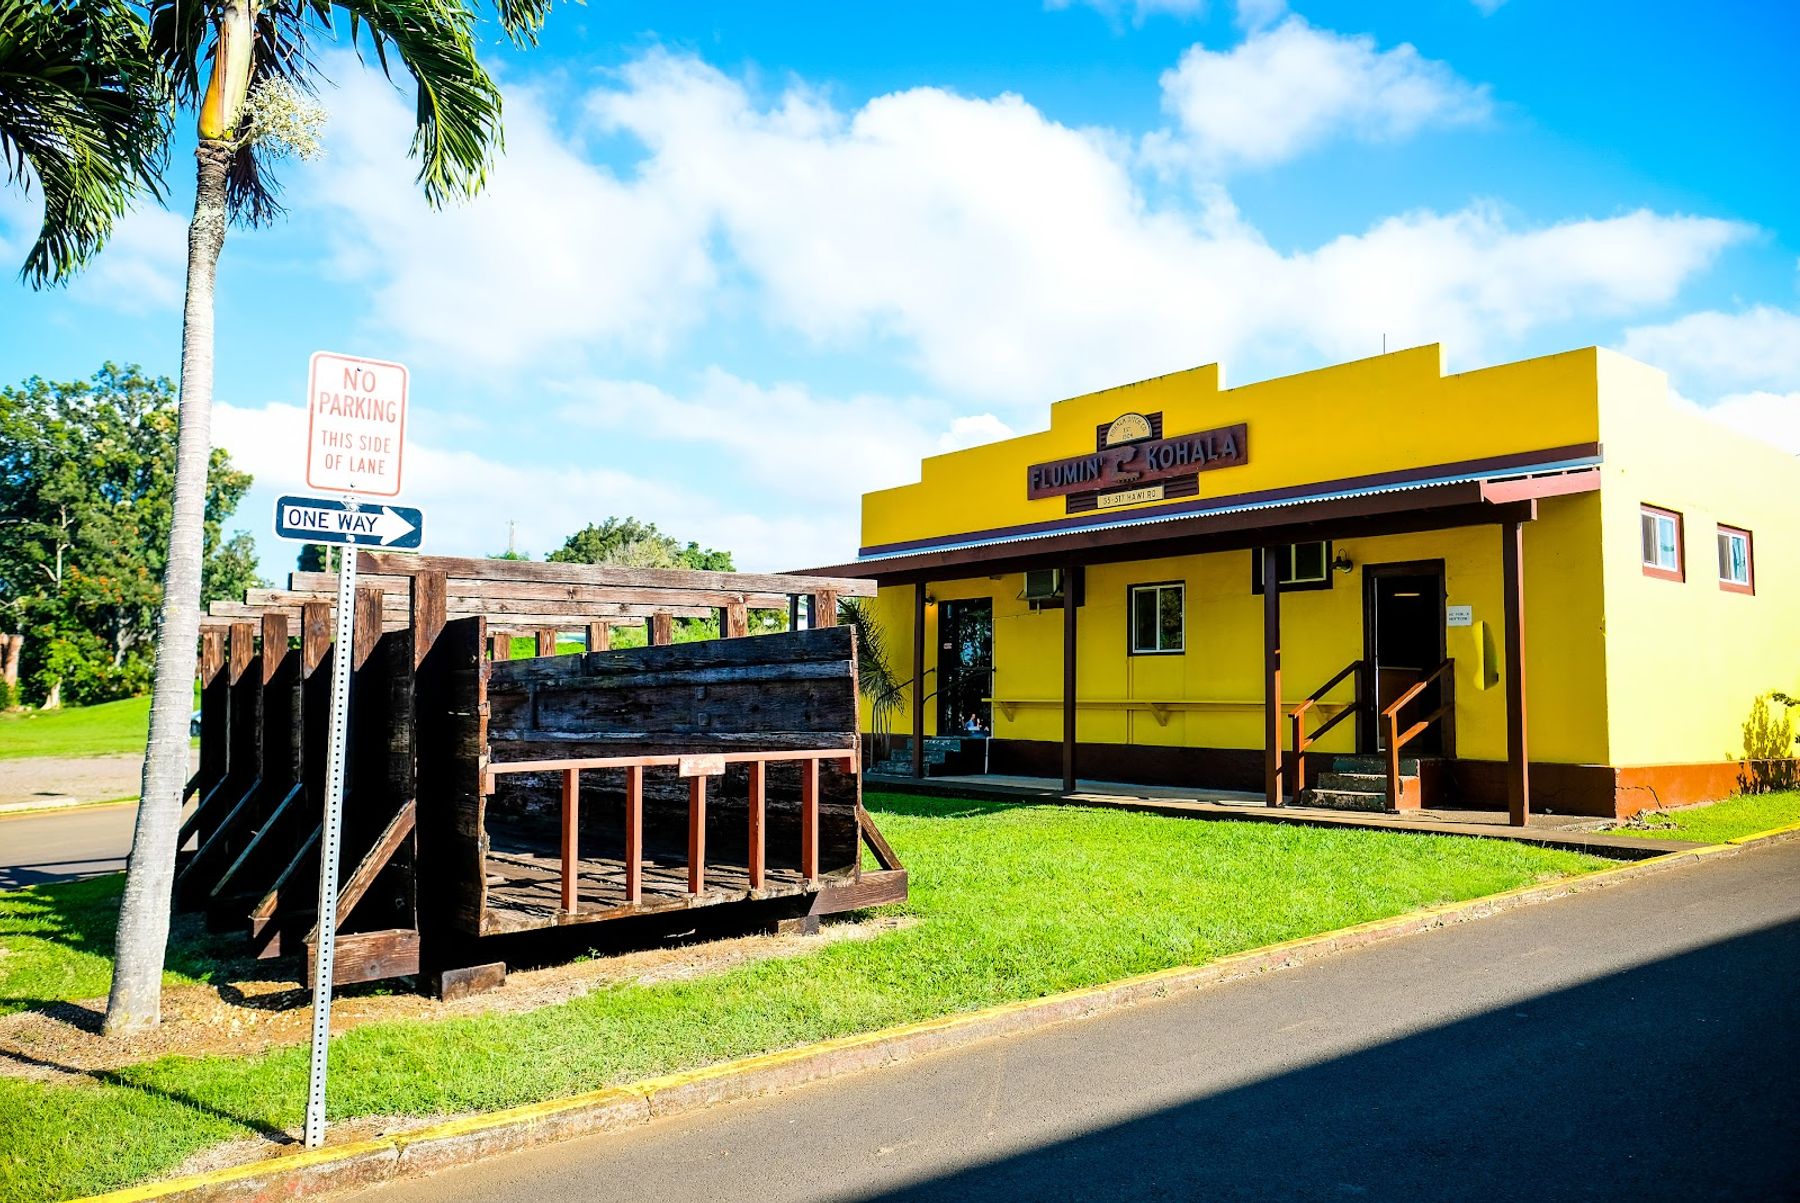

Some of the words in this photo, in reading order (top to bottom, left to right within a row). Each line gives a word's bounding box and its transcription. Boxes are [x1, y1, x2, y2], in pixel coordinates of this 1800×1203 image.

[343, 368, 376, 393] NO
[319, 391, 396, 423] PARKING
[321, 429, 353, 449] THIS
[359, 435, 391, 454] SIDE
[1146, 433, 1238, 472] KOHALA
[325, 453, 343, 470] OF
[349, 457, 385, 475] LANE
[288, 508, 330, 529] ONE
[338, 512, 379, 533] WAY
